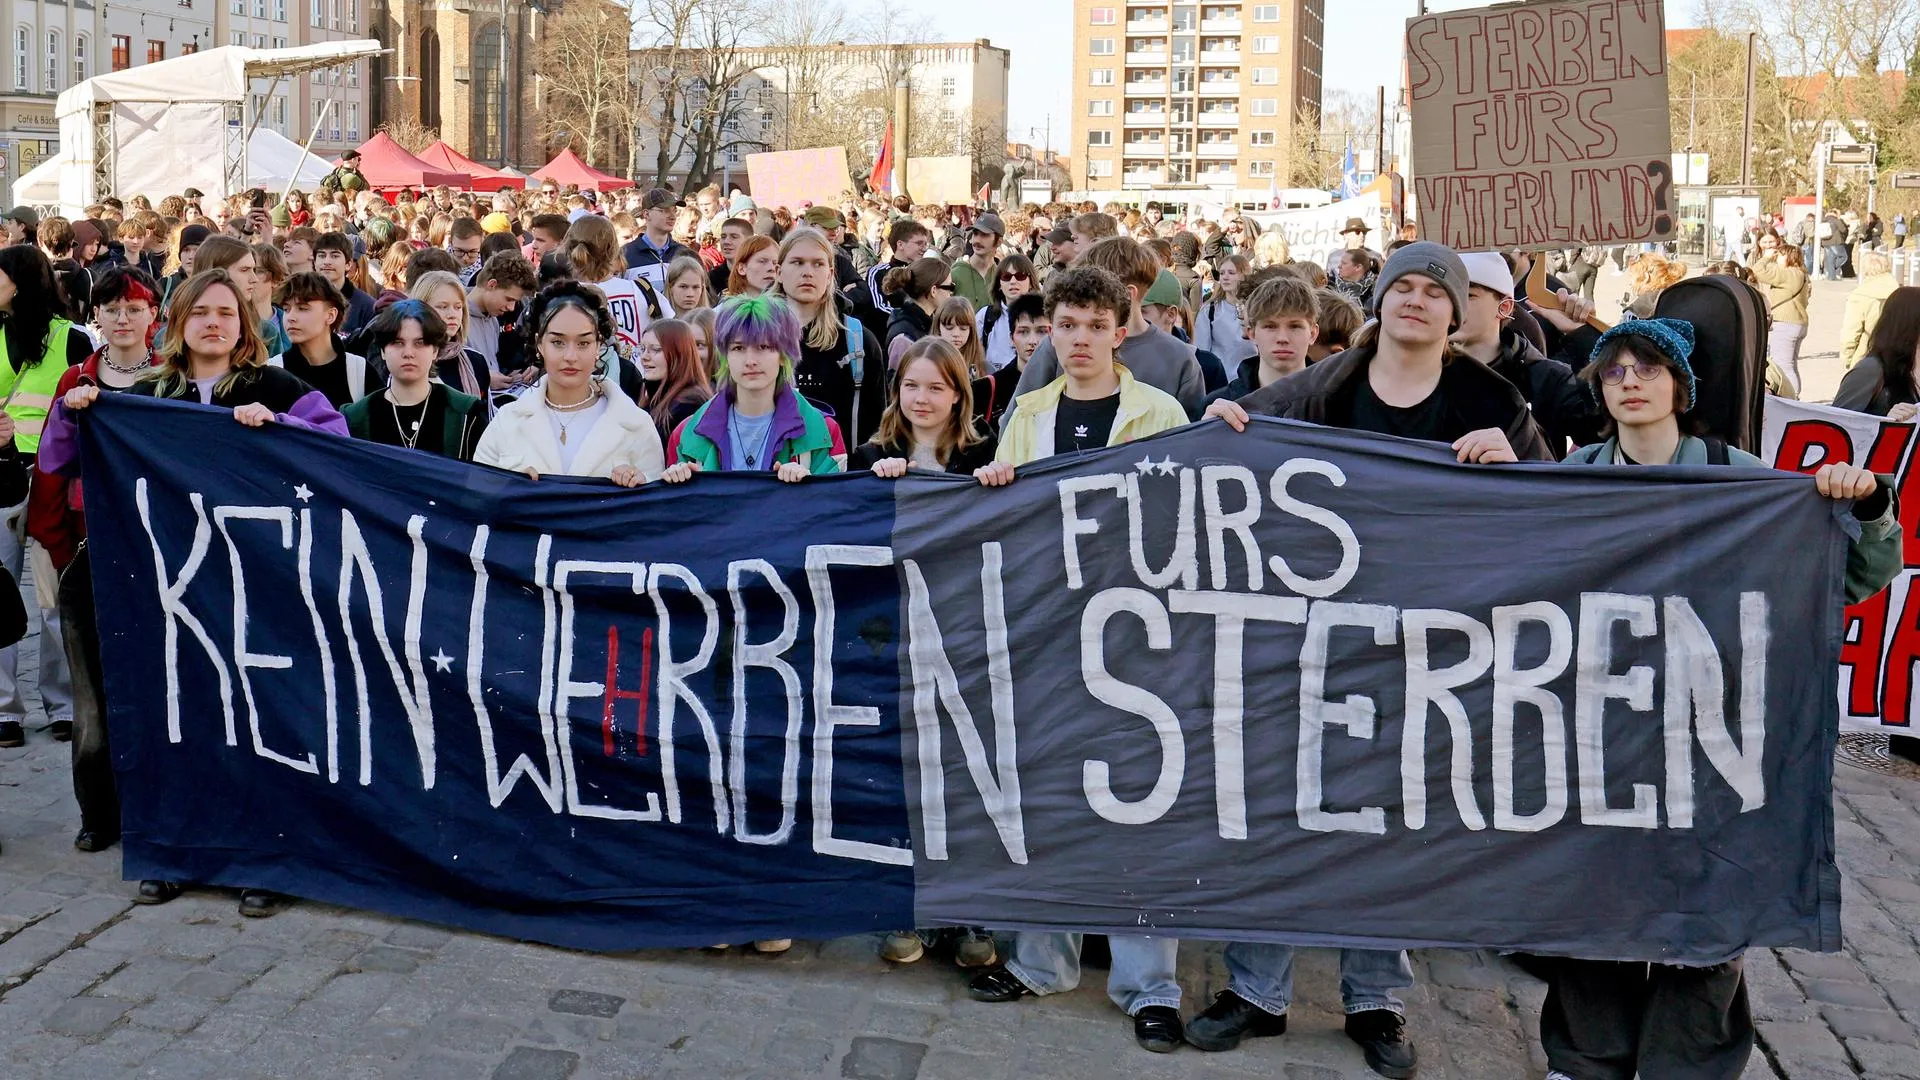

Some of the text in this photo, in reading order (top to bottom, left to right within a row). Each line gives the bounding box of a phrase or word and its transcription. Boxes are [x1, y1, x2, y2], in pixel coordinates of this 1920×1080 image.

[1407, 0, 1664, 100] STERBEN
[1453, 88, 1617, 170] FÜRS
[1415, 160, 1672, 249] VATERLAND?
[1058, 454, 1361, 598] FÜRS
[1080, 587, 1768, 841] STERBEN
